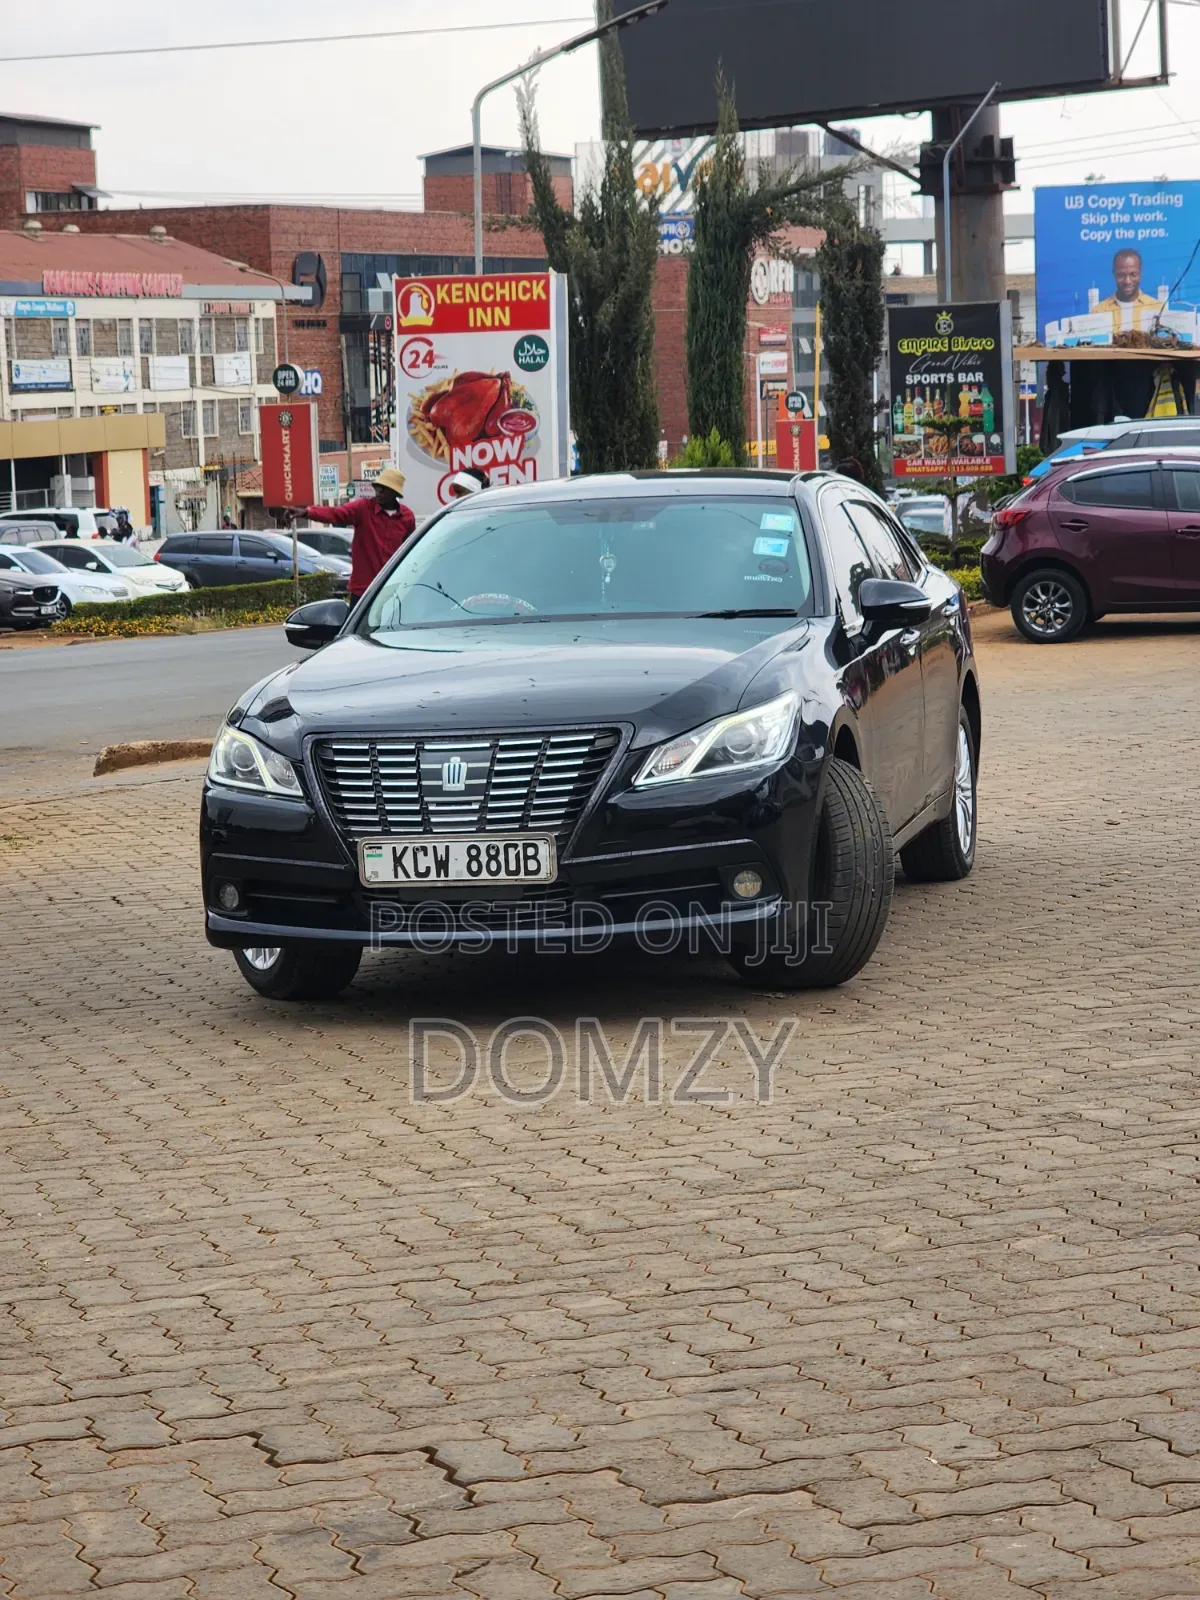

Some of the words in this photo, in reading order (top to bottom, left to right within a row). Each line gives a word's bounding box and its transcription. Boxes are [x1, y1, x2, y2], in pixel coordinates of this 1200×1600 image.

[1088, 194, 1125, 210] Copy
[1129, 192, 1183, 207] Trading
[1081, 213, 1108, 226] Skip
[1111, 212, 1131, 223] the
[1134, 211, 1168, 222] work.
[1081, 229, 1112, 243] Copy
[1115, 227, 1135, 239] the
[1138, 228, 1169, 240] pros.
[436, 280, 547, 304] KENCHICK
[469, 306, 511, 328] INN
[518, 341, 547, 357] حلال
[408, 350, 435, 369] 24
[518, 356, 547, 365] HALAL
[277, 370, 295, 380] OPEN
[905, 373, 955, 385] SPORTS
[957, 372, 985, 383] BAR
[452, 434, 523, 471] NOW
[281, 428, 293, 503] QUICKMART
[906, 459, 922, 467] CAR
[392, 844, 451, 879] KCW
[466, 842, 542, 878] 880B
